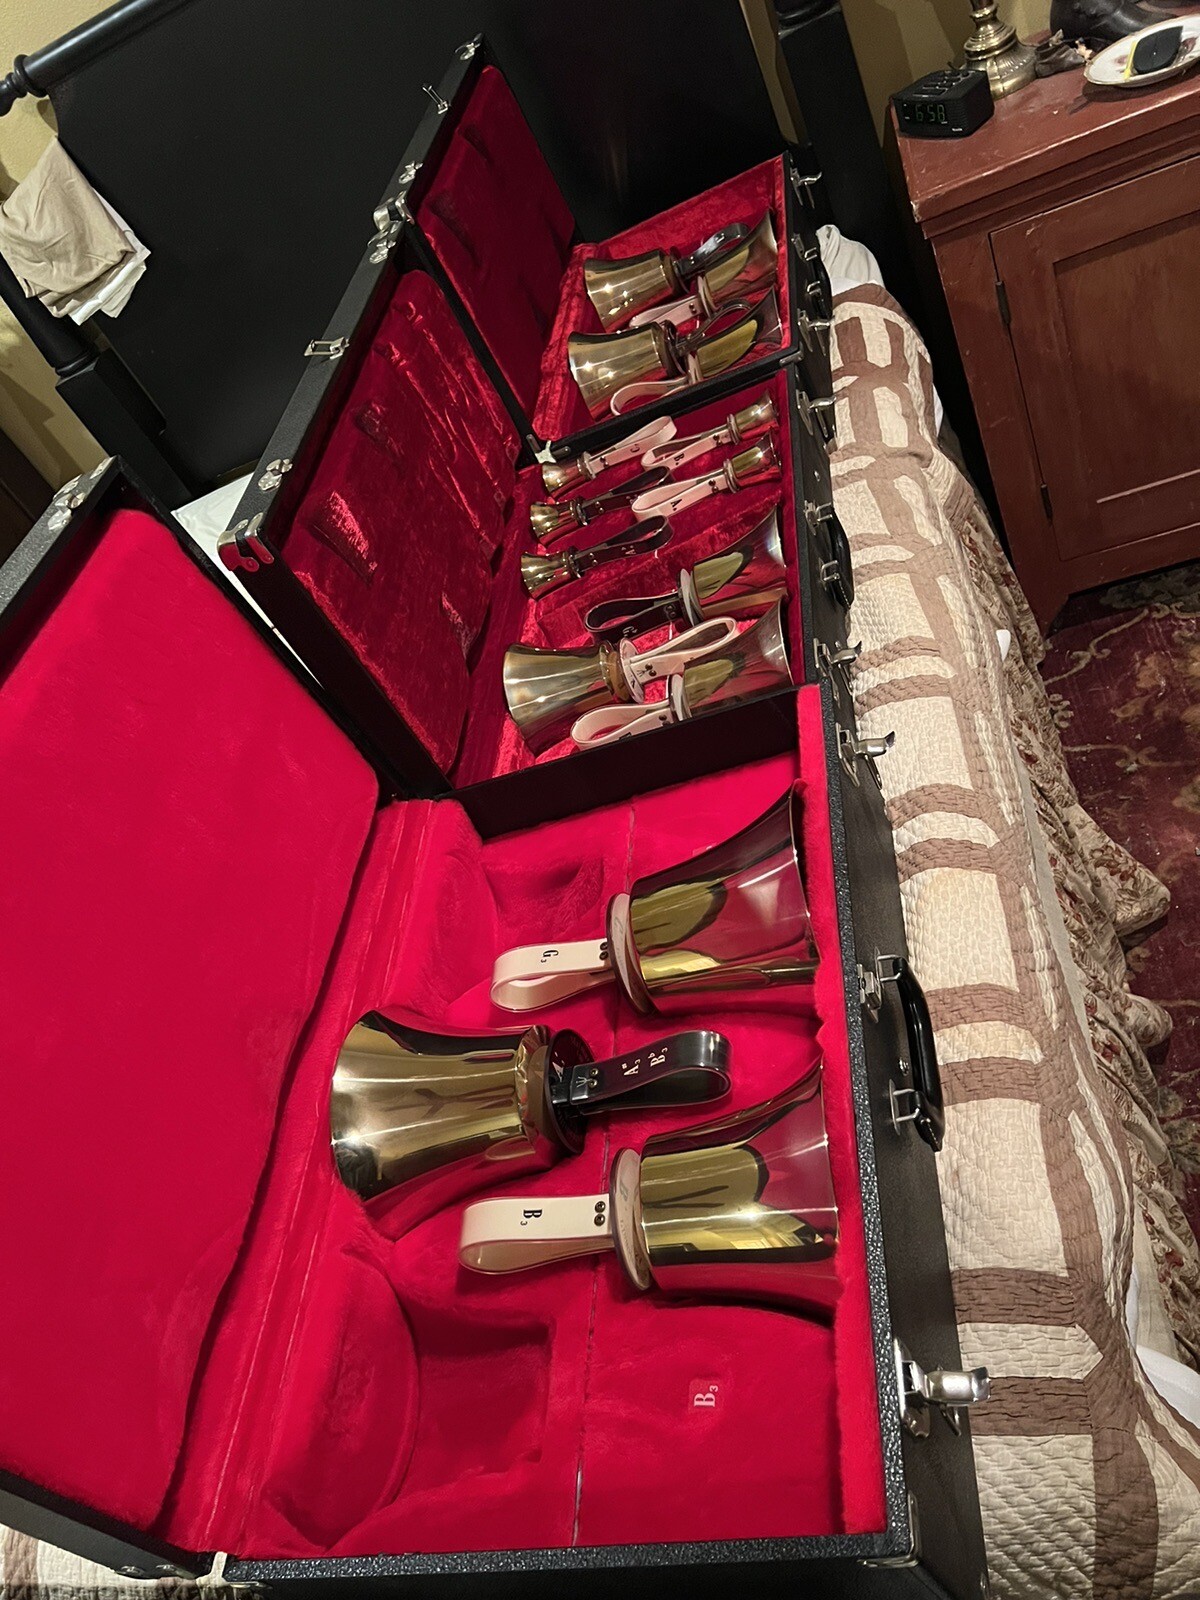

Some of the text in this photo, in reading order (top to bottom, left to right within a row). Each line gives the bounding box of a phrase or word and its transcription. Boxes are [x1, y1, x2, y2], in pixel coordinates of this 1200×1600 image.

[630, 443, 641, 453] C
[673, 452, 685, 466] B
[670, 498, 683, 512] A
[540, 949, 559, 963] G3
[520, 1209, 543, 1226] B3
[693, 1385, 719, 1408] B3
